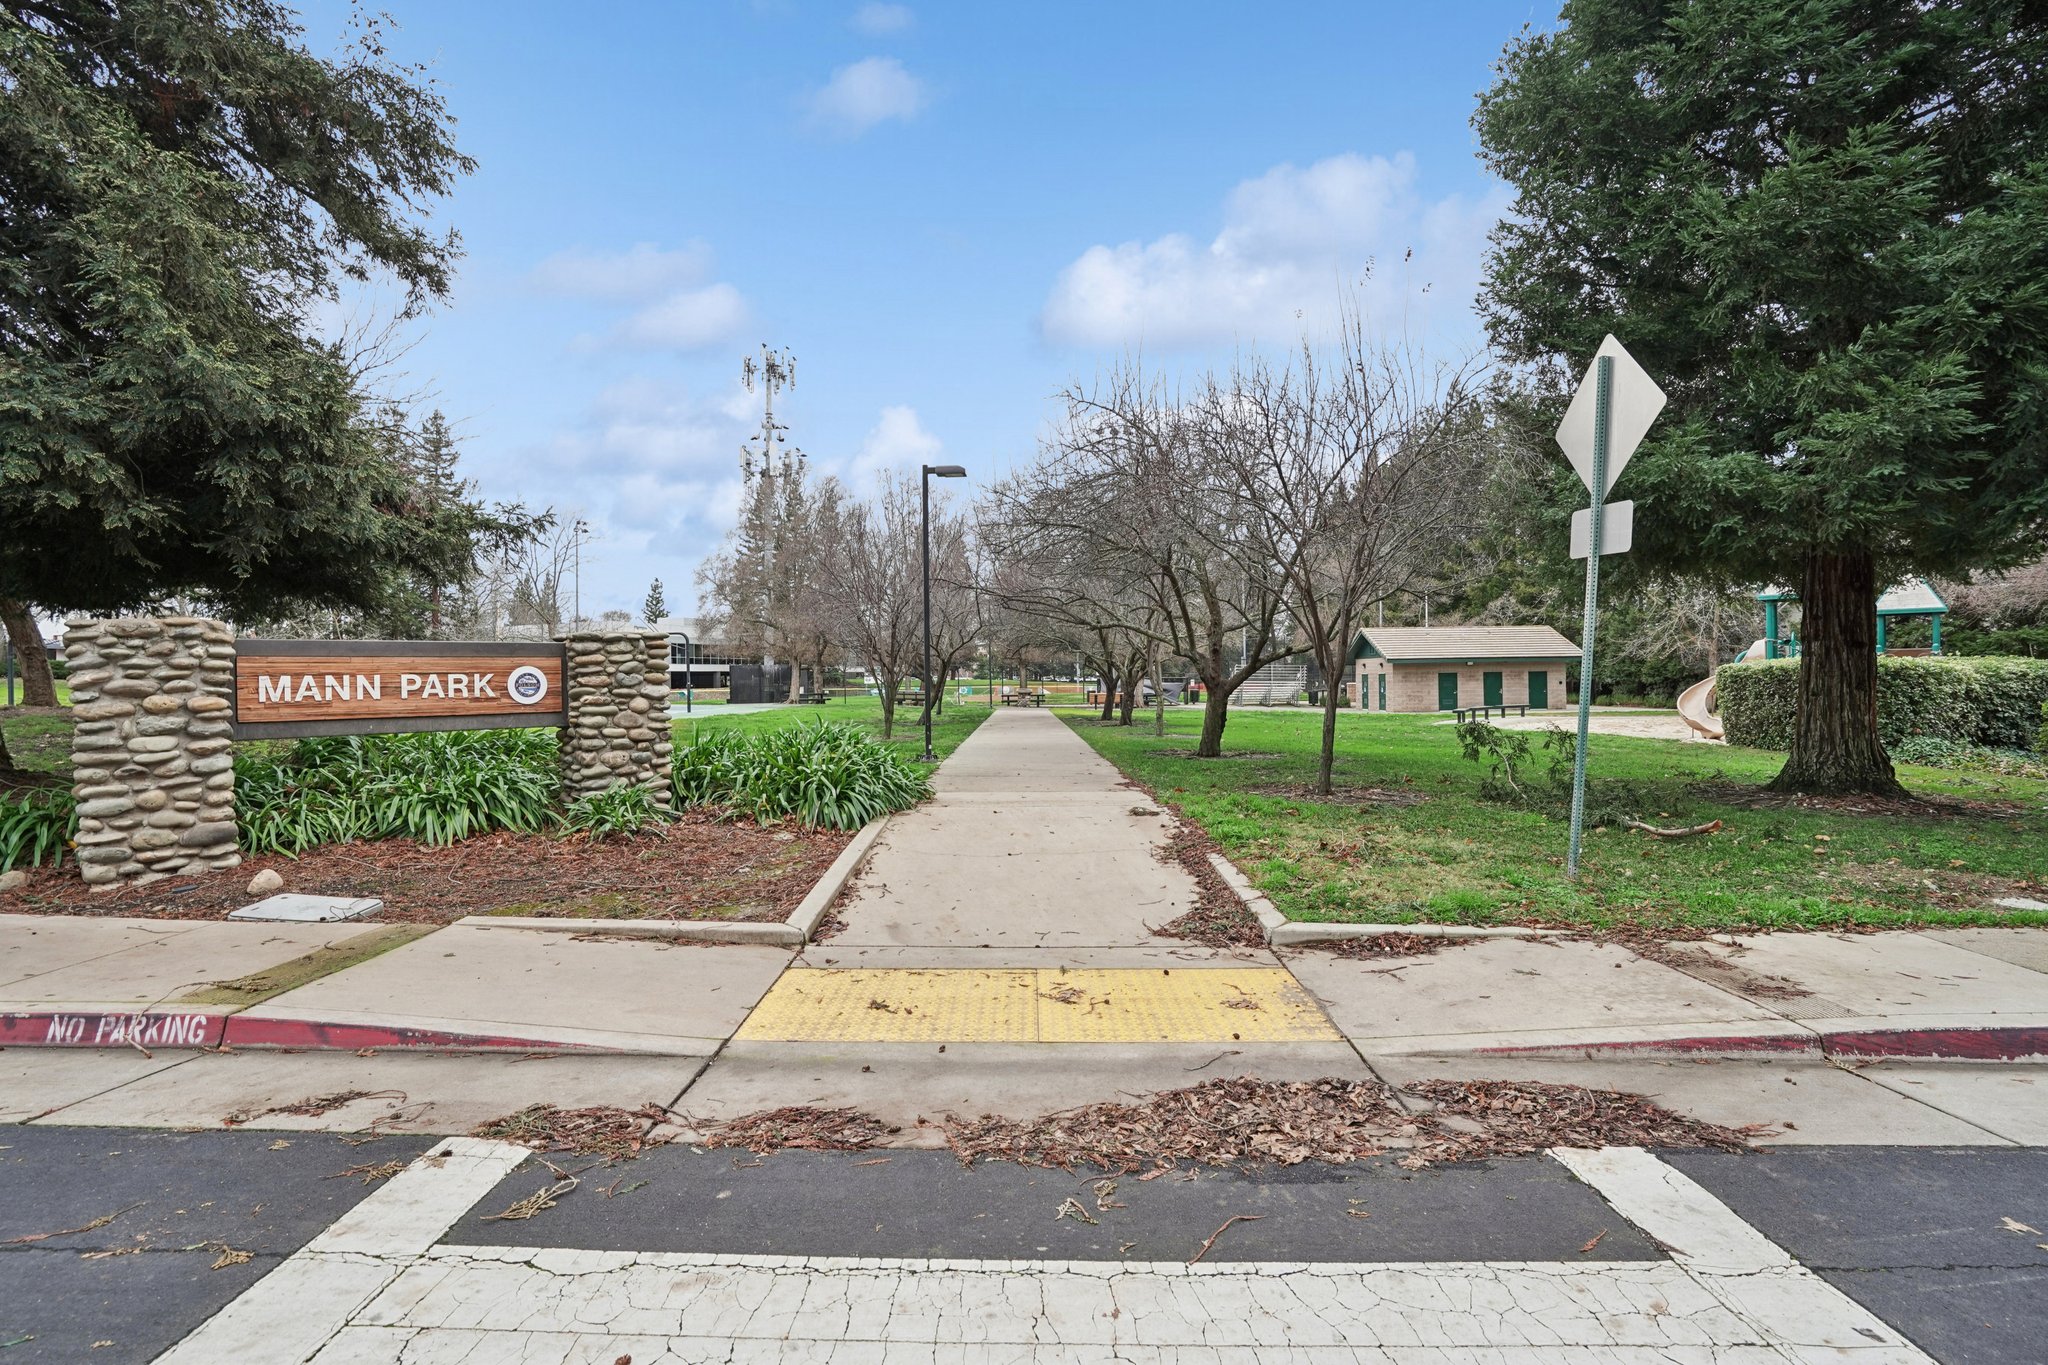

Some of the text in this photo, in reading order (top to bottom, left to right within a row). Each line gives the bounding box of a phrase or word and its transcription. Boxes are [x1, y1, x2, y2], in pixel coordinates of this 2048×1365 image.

[258, 674, 381, 703] MANN
[400, 673, 496, 700] PARK
[47, 1014, 208, 1044] NO PARKING
